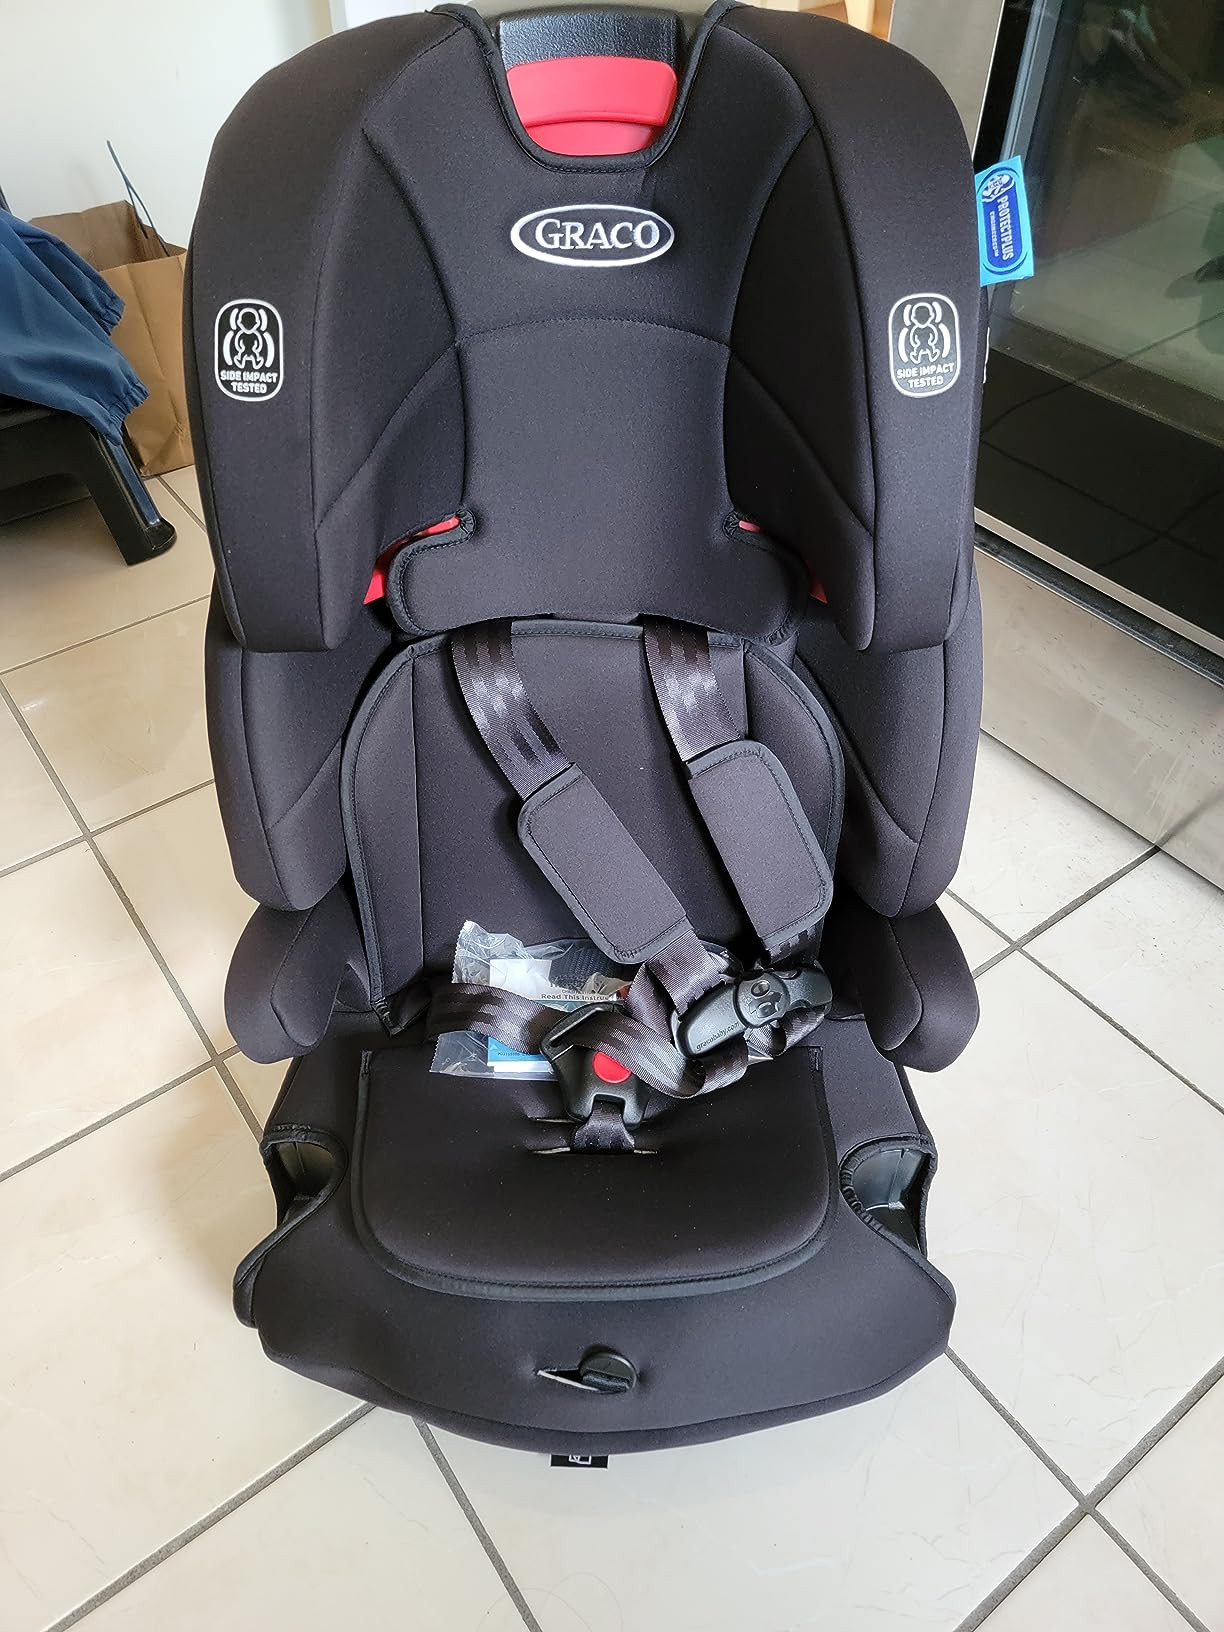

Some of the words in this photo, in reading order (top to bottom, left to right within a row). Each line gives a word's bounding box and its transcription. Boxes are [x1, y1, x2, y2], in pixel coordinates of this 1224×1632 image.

[535, 218, 660, 249] GRACO
[997, 195, 1014, 260] PROTECTPLUS
[220, 370, 241, 381] SIDE
[243, 371, 278, 383] IMPACT
[896, 367, 918, 379] SIDE
[920, 362, 954, 376] IMPACT
[231, 382, 267, 393] TESTED
[908, 376, 943, 388] TESTED
[696, 1021, 739, 1050] gracobaby.com
